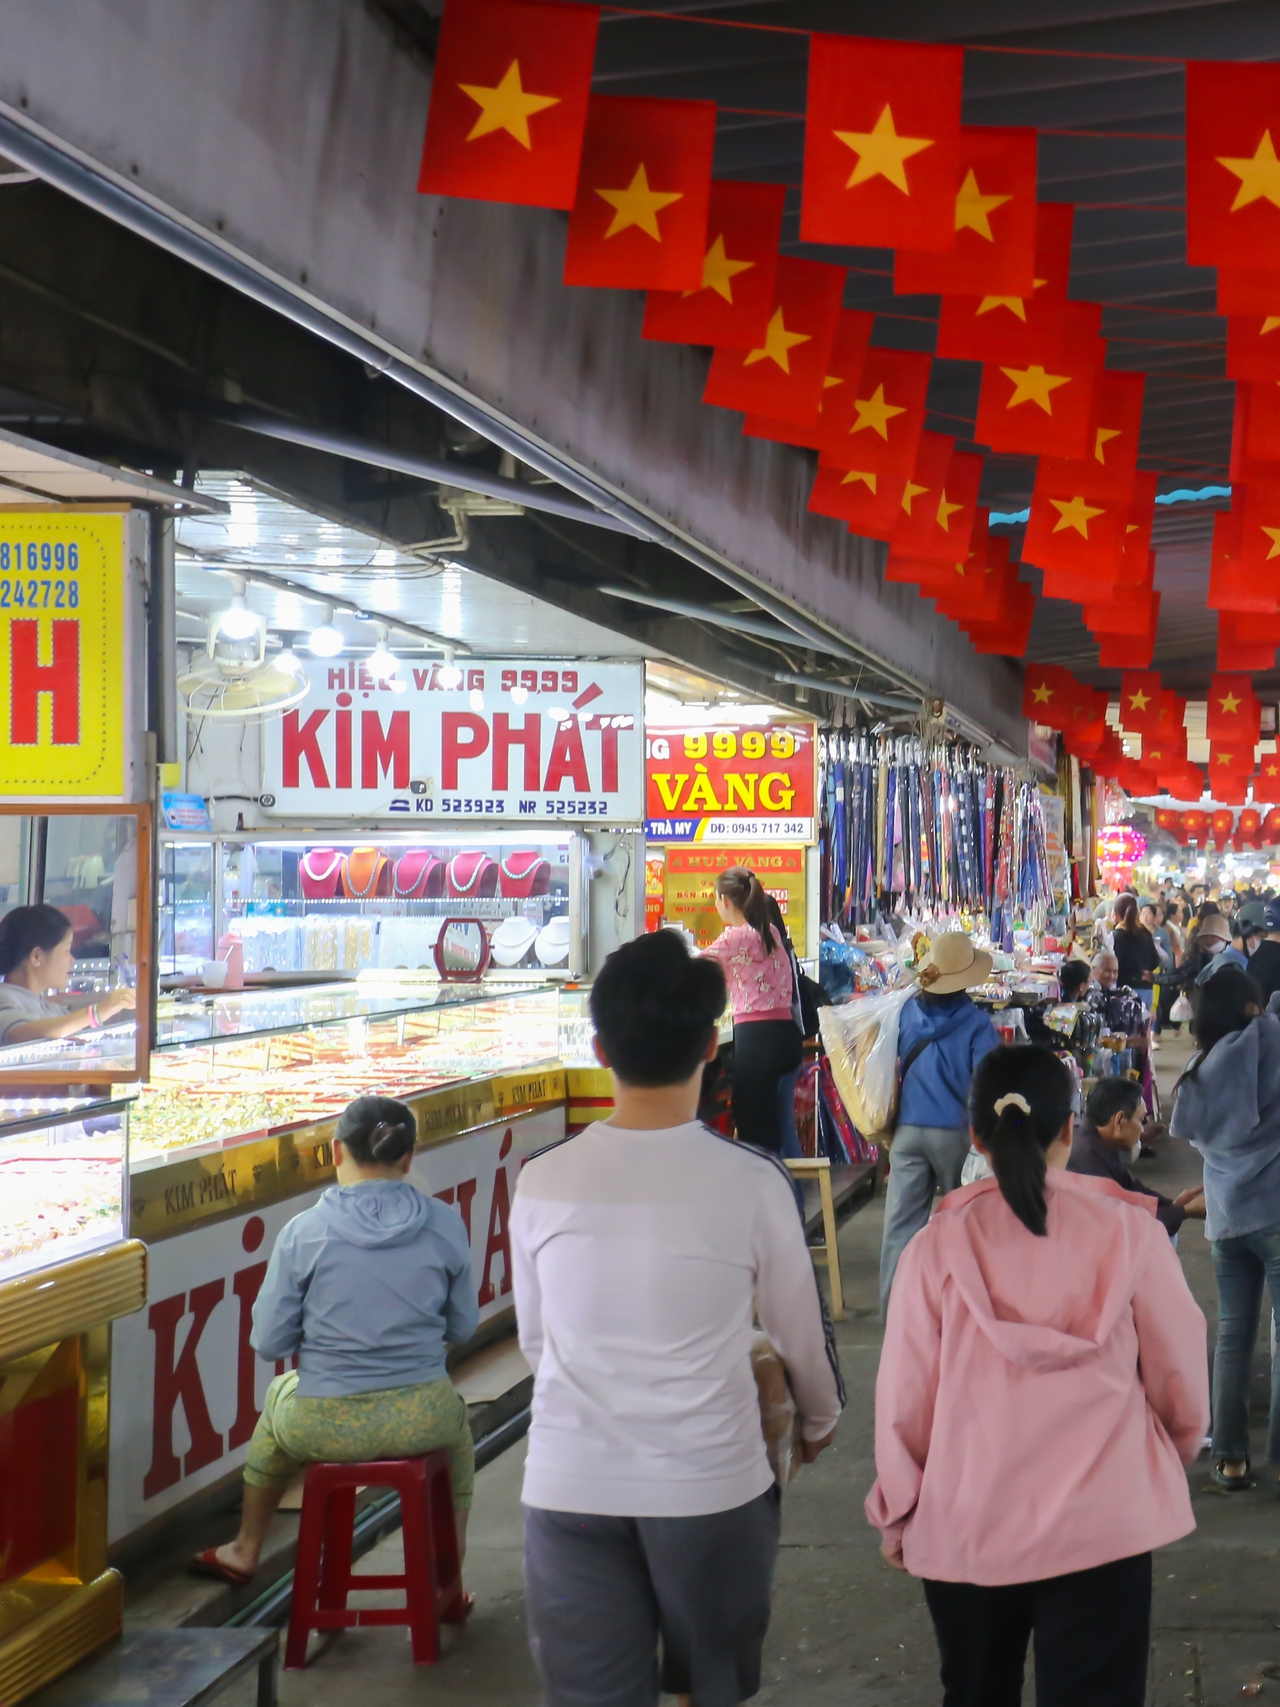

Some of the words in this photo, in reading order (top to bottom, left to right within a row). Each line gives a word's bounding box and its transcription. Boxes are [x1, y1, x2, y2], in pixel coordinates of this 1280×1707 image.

[441, 682, 634, 793] PHÁT
[683, 731, 796, 760] 9999
[652, 762, 796, 812] VÀNG
[416, 798, 433, 813] KD
[441, 798, 505, 814] 523923
[519, 800, 536, 814] NR
[546, 800, 608, 815] 525232
[651, 820, 672, 835] TRÀ
[675, 821, 692, 835] MY
[762, 822, 780, 834] 717
[784, 822, 804, 834] 342
[688, 851, 728, 867] HUẾ
[734, 853, 783, 868] VÀNG
[164, 1181, 195, 1215] KIM
[200, 1162, 237, 1206] PHÁT
